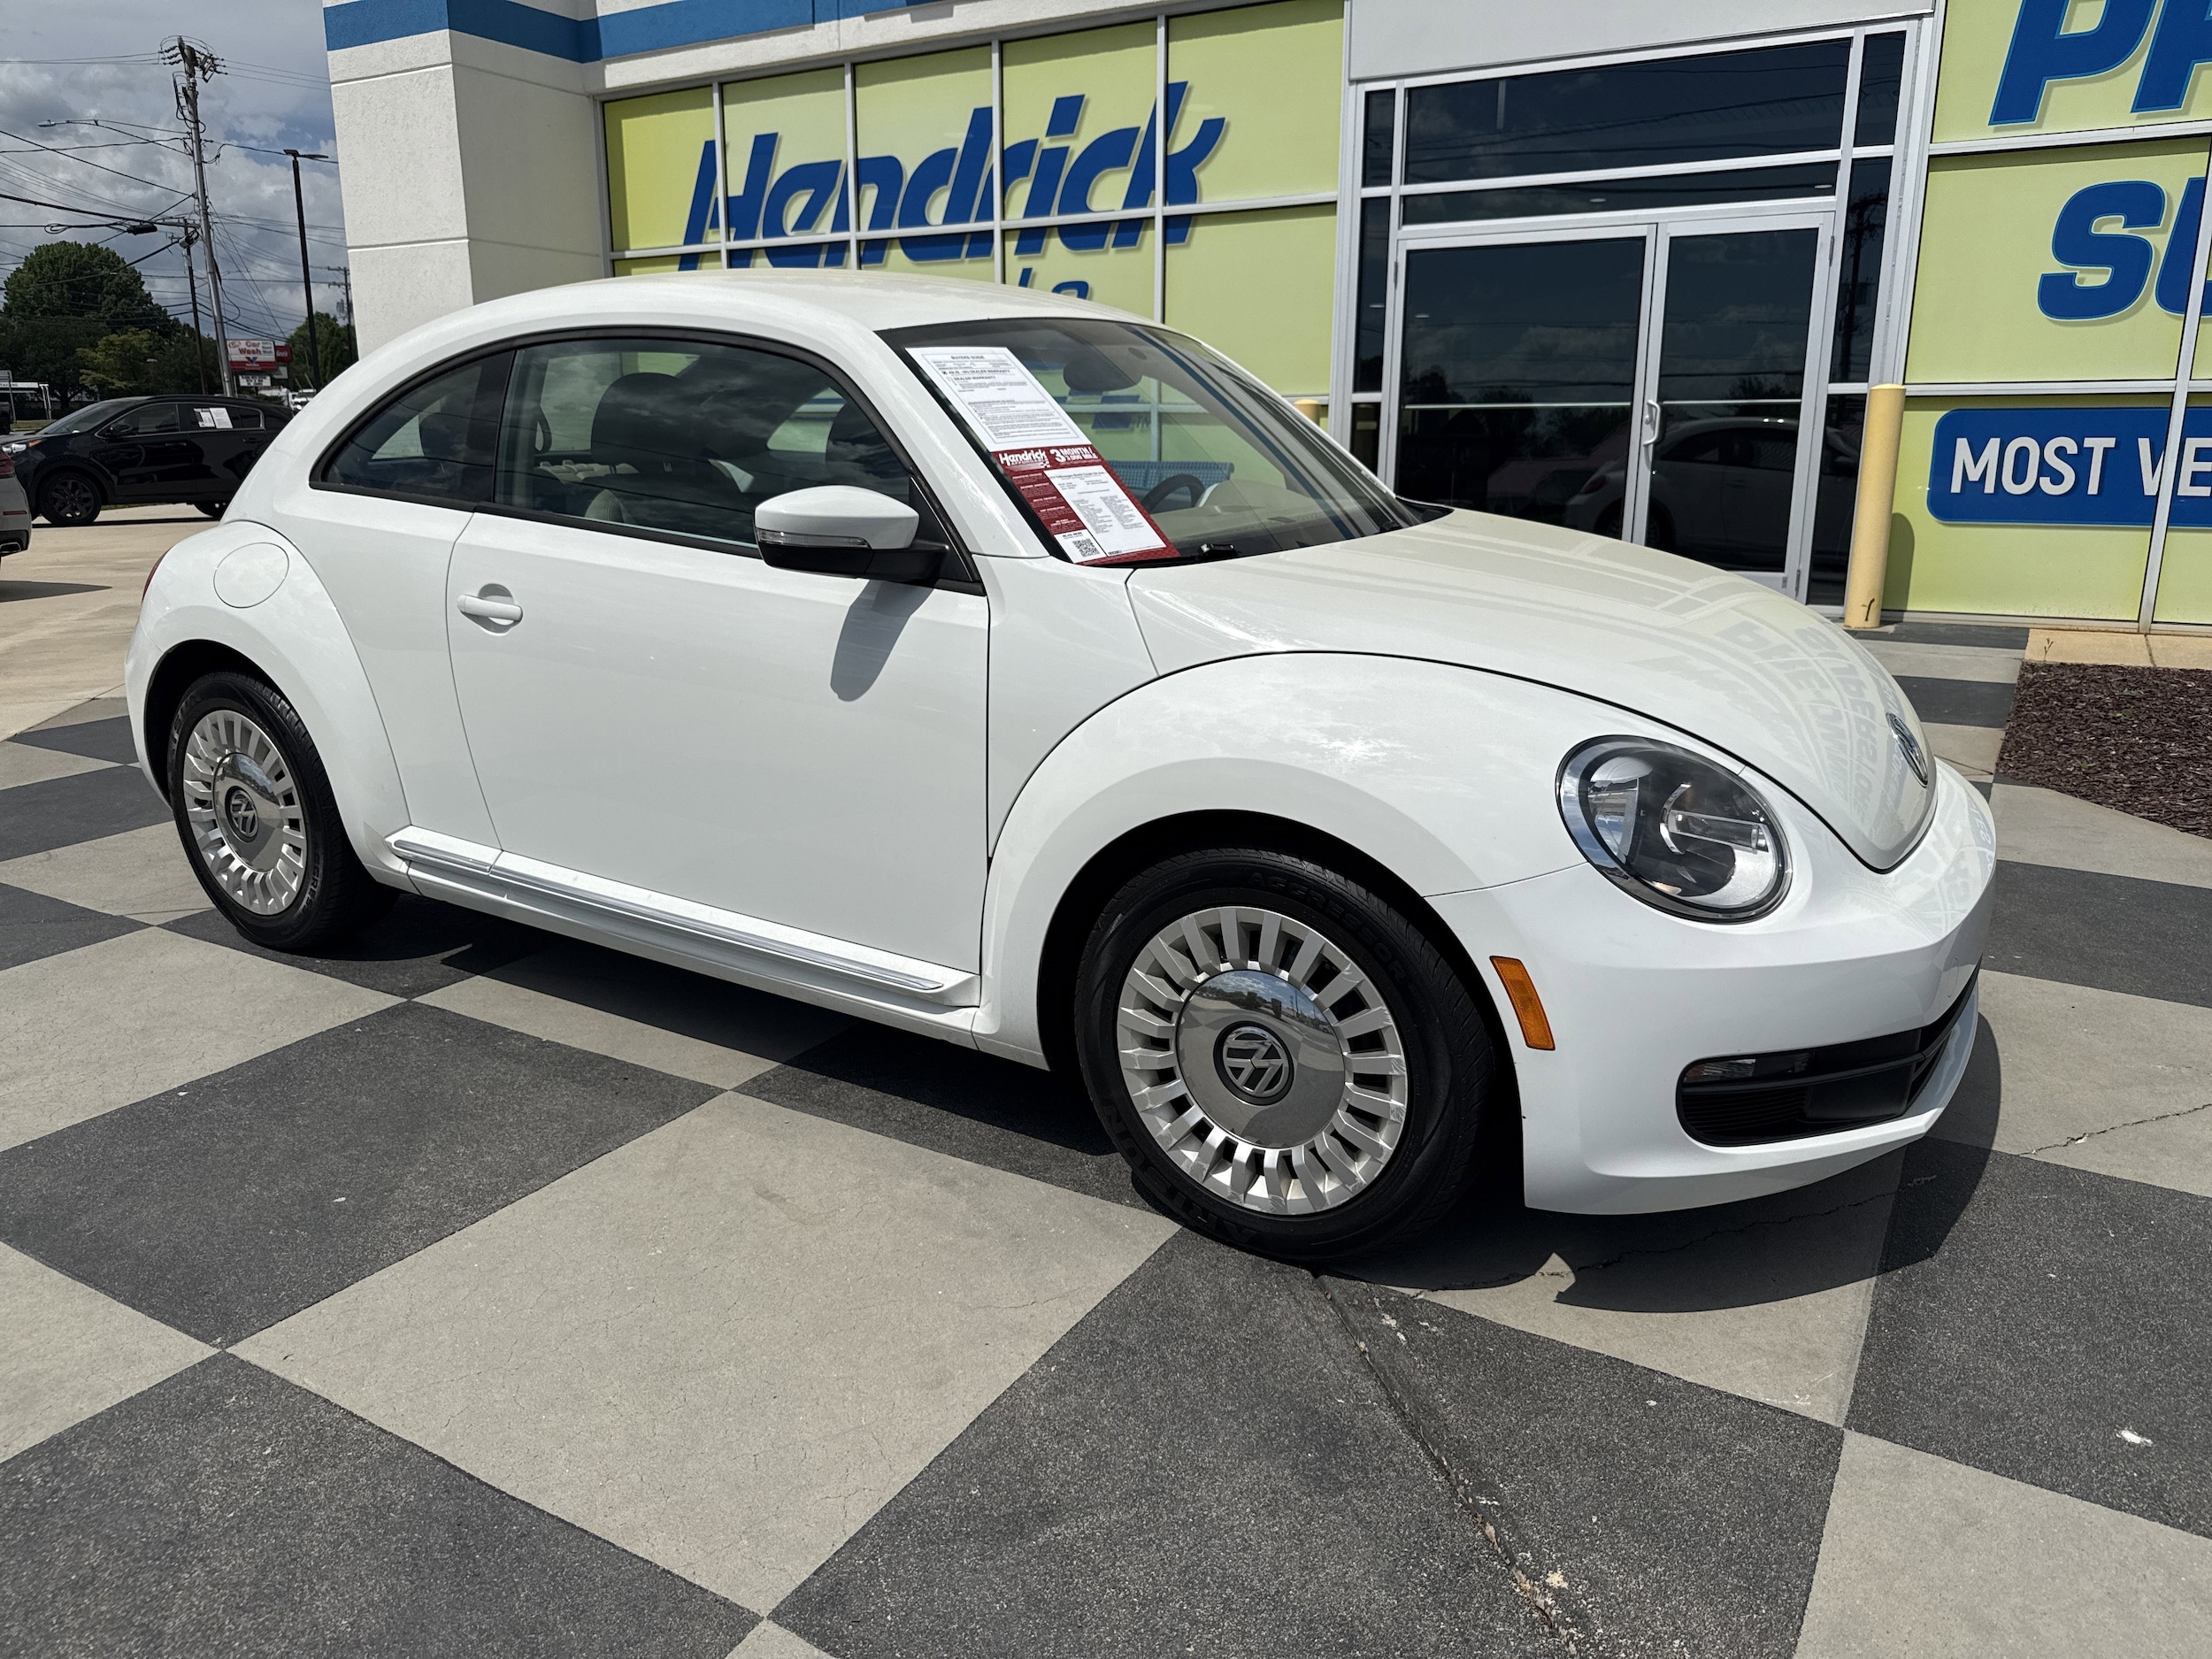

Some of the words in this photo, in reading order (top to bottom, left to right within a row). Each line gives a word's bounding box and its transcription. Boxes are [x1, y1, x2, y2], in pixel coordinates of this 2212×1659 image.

[679, 81, 1225, 272] Hendrick
[998, 449, 1048, 466] Hendrick
[1049, 449, 1066, 463] 3
[1950, 436, 2116, 495] MOST
[1248, 872, 1407, 982] AGGRESSOR
